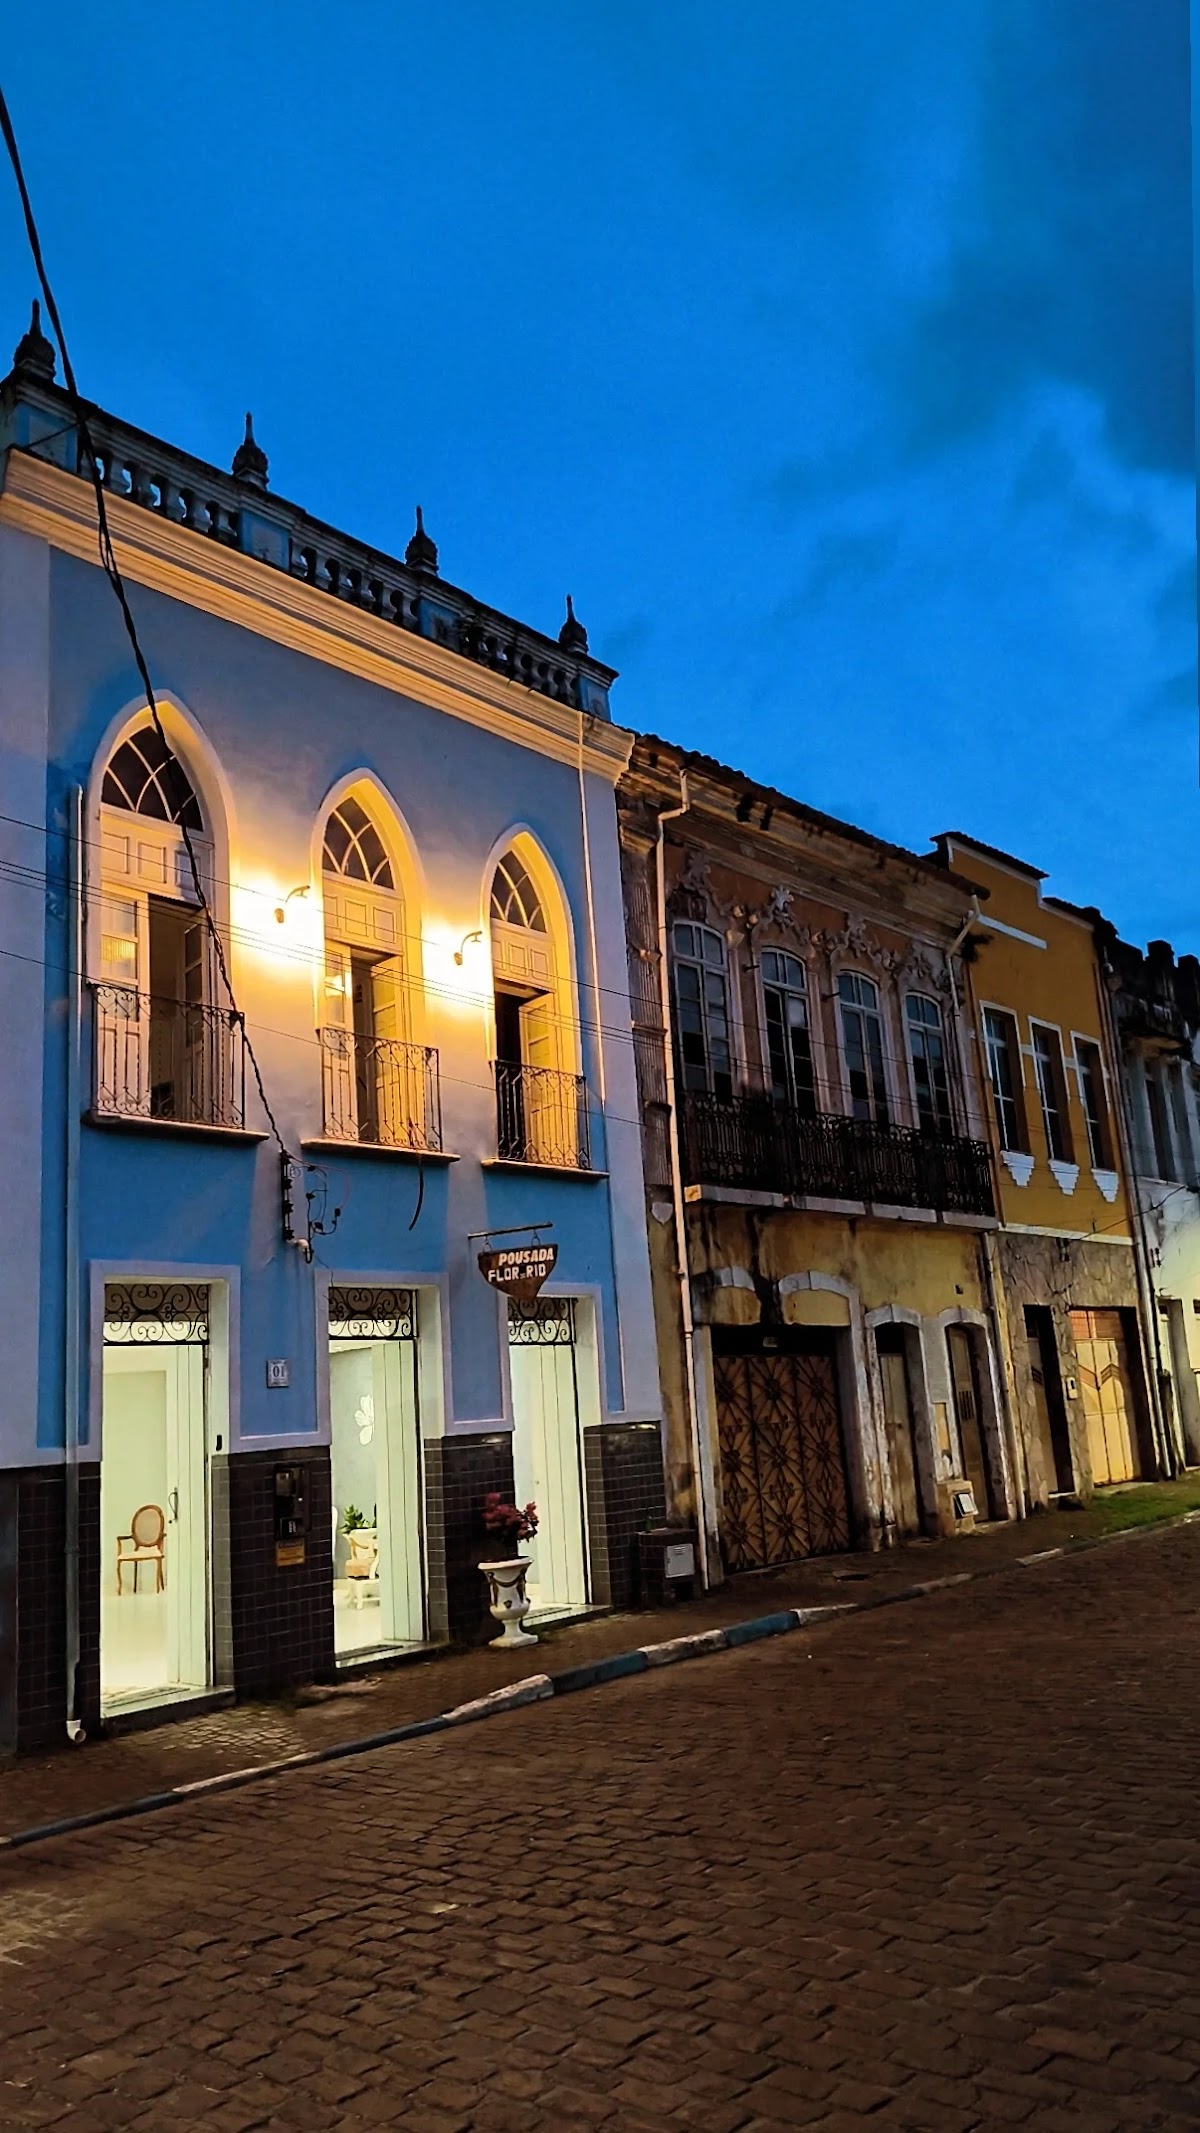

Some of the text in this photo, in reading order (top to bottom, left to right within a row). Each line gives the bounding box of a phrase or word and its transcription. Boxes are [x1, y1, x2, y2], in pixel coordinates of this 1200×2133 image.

[498, 1247, 554, 1266] POUSADA
[488, 1266, 519, 1282] FLOR
[526, 1263, 546, 1278] RIO
[273, 1365, 284, 1377] 01
